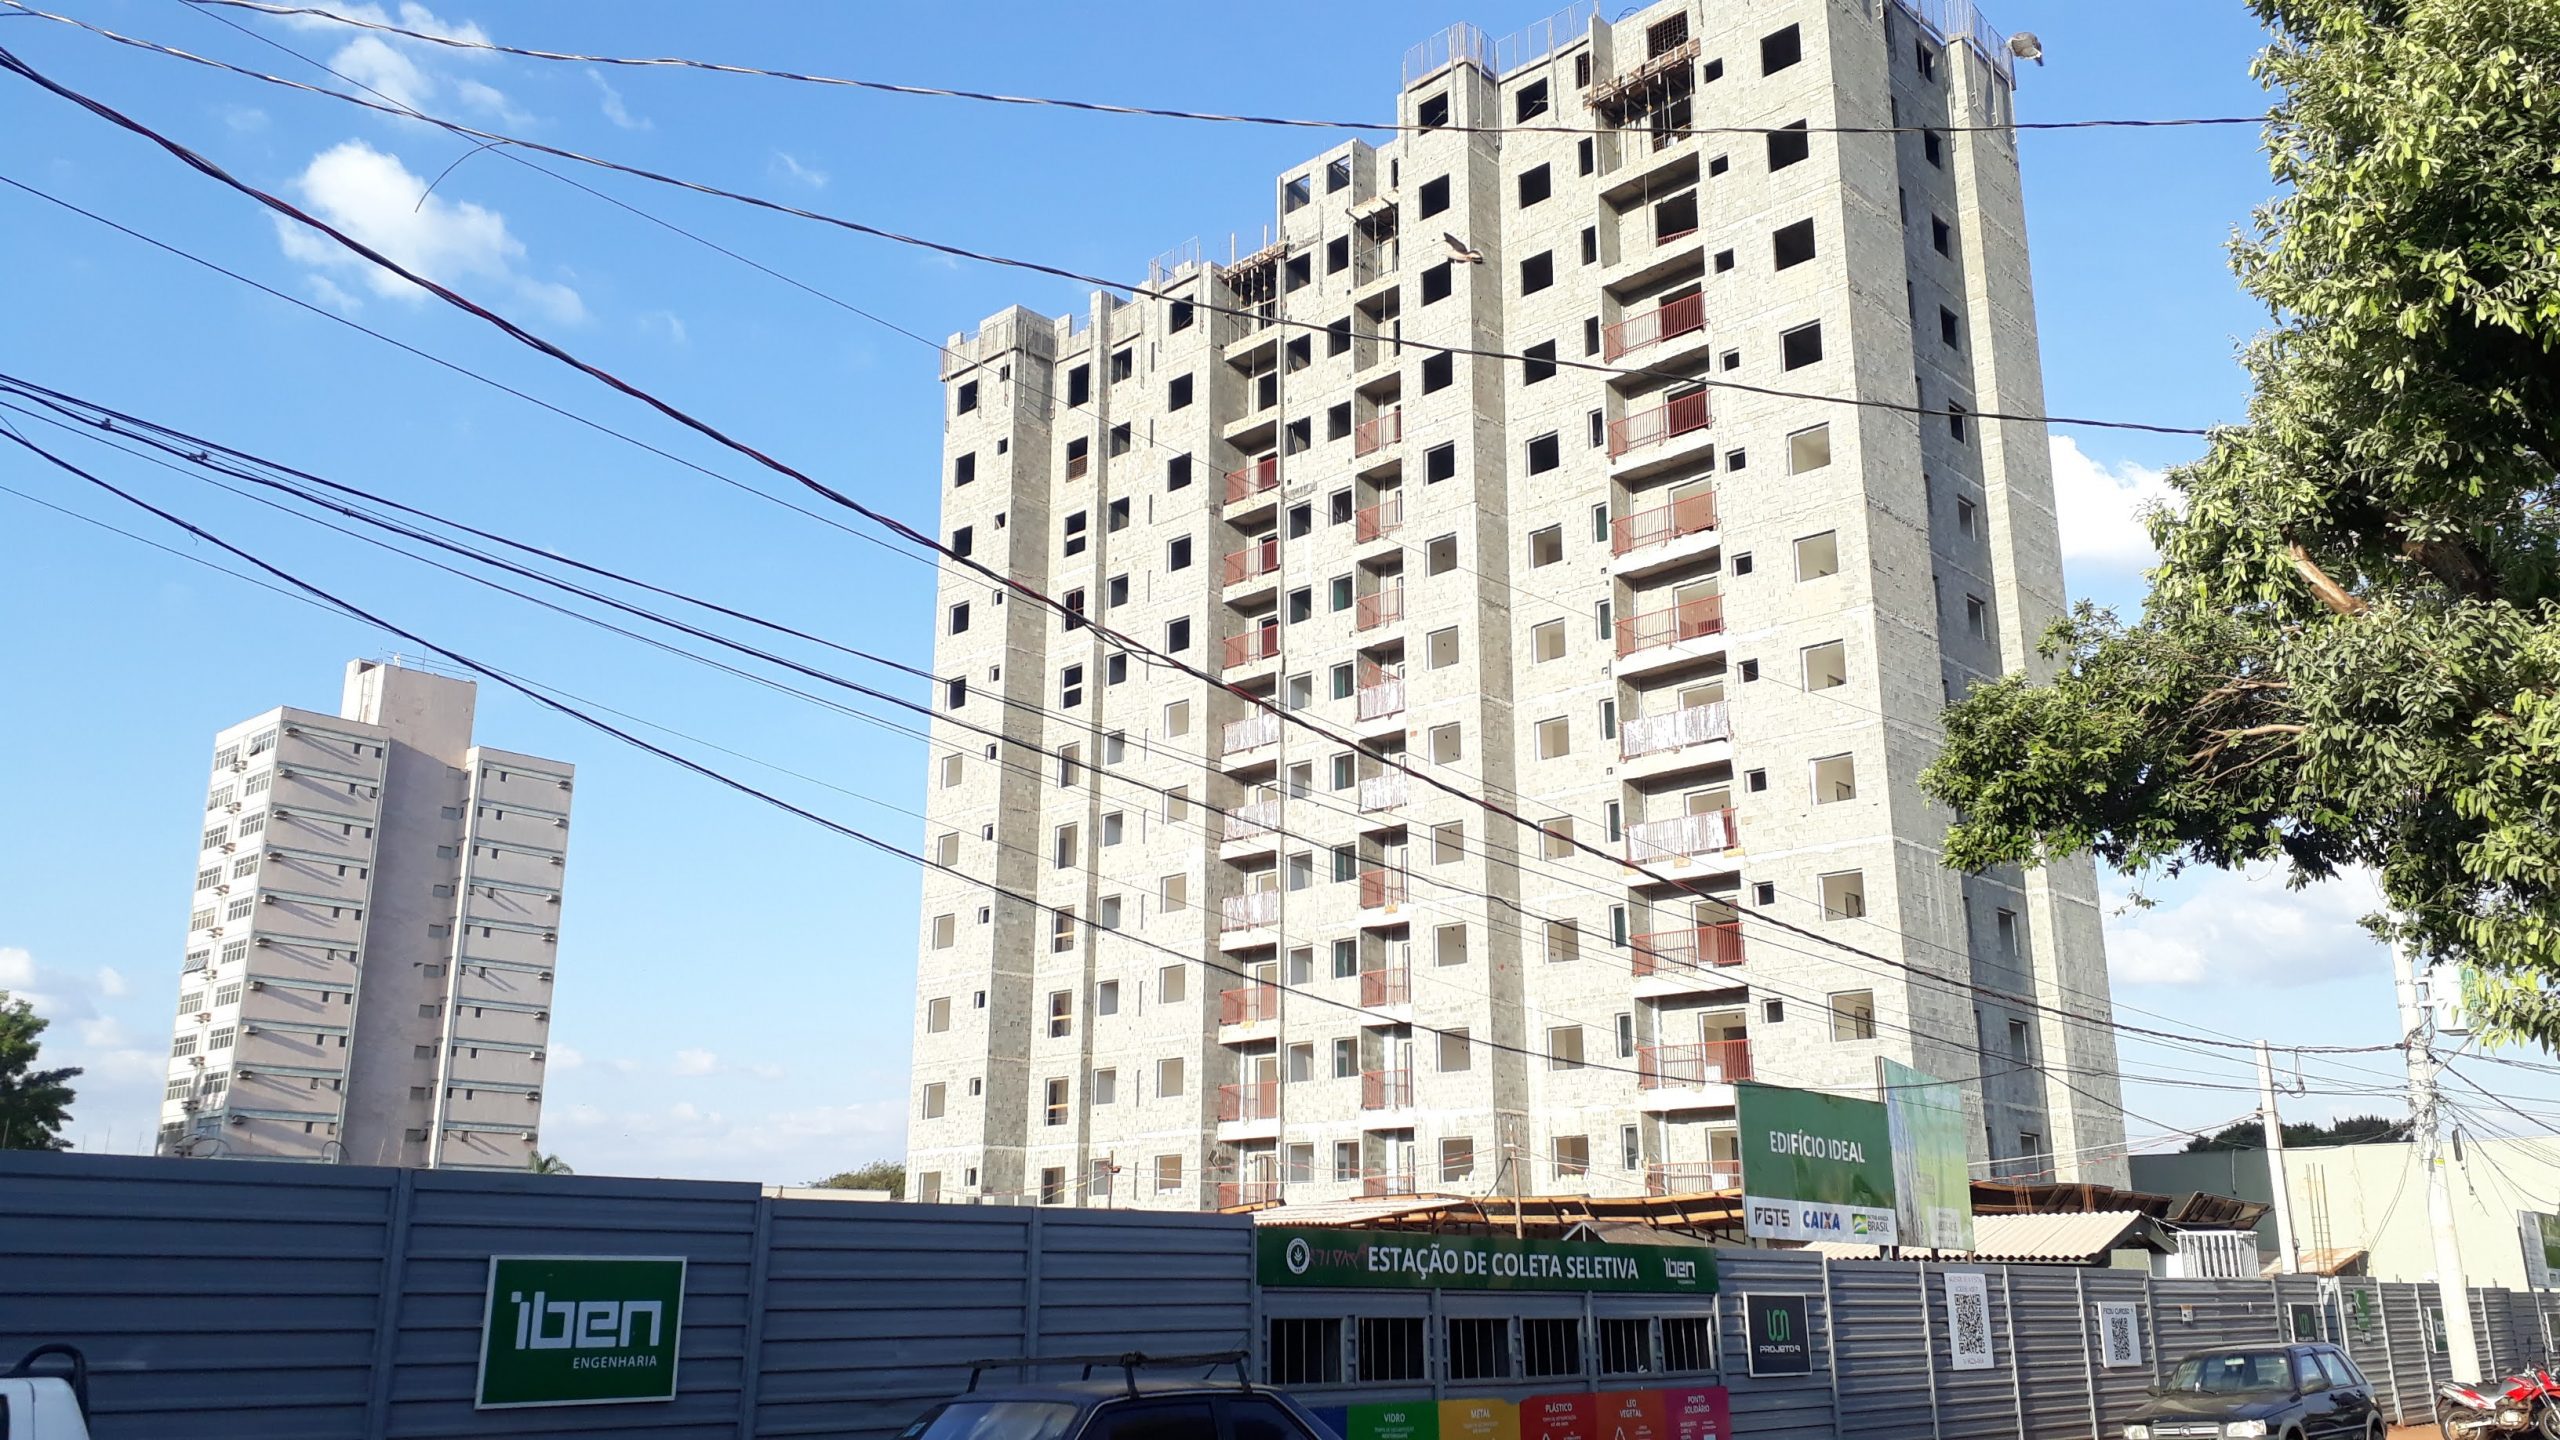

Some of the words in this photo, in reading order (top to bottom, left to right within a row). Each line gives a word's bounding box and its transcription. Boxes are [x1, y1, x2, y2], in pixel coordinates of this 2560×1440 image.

[1769, 1129, 1825, 1160] EDIFÍCIO
[1828, 1138, 1866, 1164] IDEAL
[1754, 1206, 1791, 1228] FGTS
[1803, 1210, 1841, 1231] CAIXA
[1867, 1220, 1890, 1233] BRASIL
[1368, 1243, 1459, 1281] ESTAÇÃO
[1464, 1250, 1488, 1276] DE
[1491, 1251, 1563, 1279] COLETA
[1566, 1255, 1640, 1280] SELETIVA
[511, 1291, 662, 1350] iben
[572, 1355, 657, 1370] ENGENHARIA
[1687, 1394, 1706, 1405] PONTO
[1470, 1407, 1491, 1419] METAL
[1545, 1401, 1573, 1413] PLÁSTICO
[1619, 1408, 1643, 1418] VEGETAL
[1383, 1412, 1406, 1423] VIDRO
